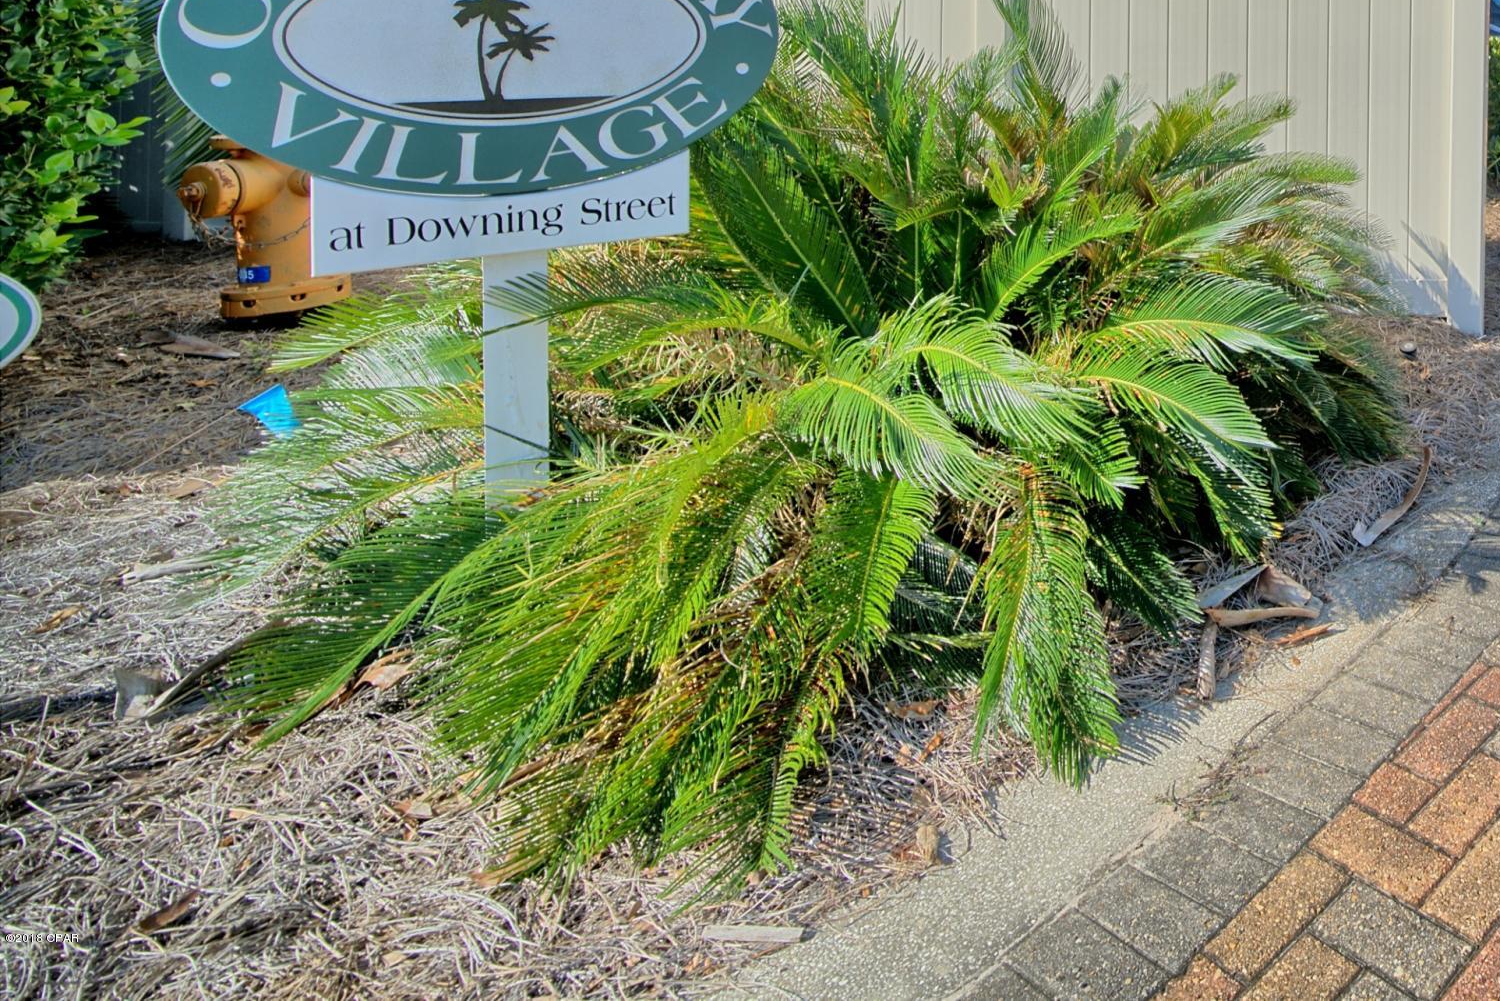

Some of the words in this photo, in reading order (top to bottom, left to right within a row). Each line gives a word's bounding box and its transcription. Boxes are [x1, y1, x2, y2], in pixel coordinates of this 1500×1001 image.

[271, 76, 728, 185] VILLAGE
[329, 222, 366, 252] at
[387, 203, 564, 246] Downing
[580, 192, 677, 226] Street
